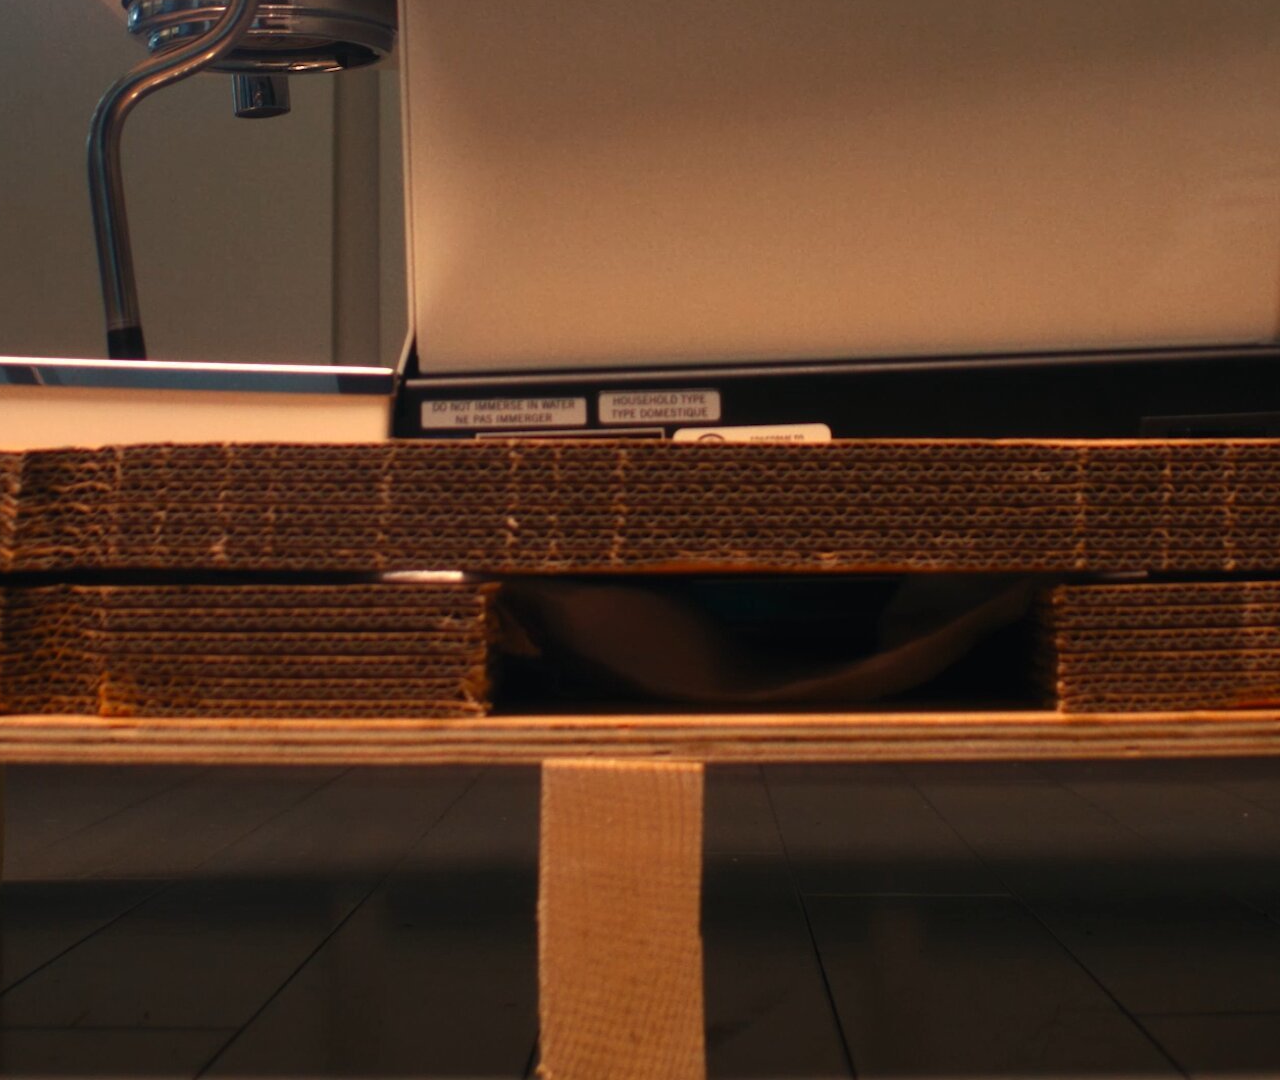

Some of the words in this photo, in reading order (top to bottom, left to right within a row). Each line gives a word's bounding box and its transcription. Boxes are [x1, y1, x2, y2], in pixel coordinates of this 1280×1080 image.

[432, 402, 448, 412] DO
[450, 401, 470, 411] NOT
[474, 400, 523, 411] IMMERSE
[526, 399, 539, 409] IN
[541, 398, 575, 409] WATER
[612, 395, 679, 406] HOUSEHOLD
[681, 394, 706, 404] TYPE
[455, 415, 468, 424] NE
[472, 414, 493, 424] PAS
[496, 413, 552, 423] IMMERGER
[611, 408, 635, 419] TYPE
[639, 406, 708, 418] DOMESTIQUE
